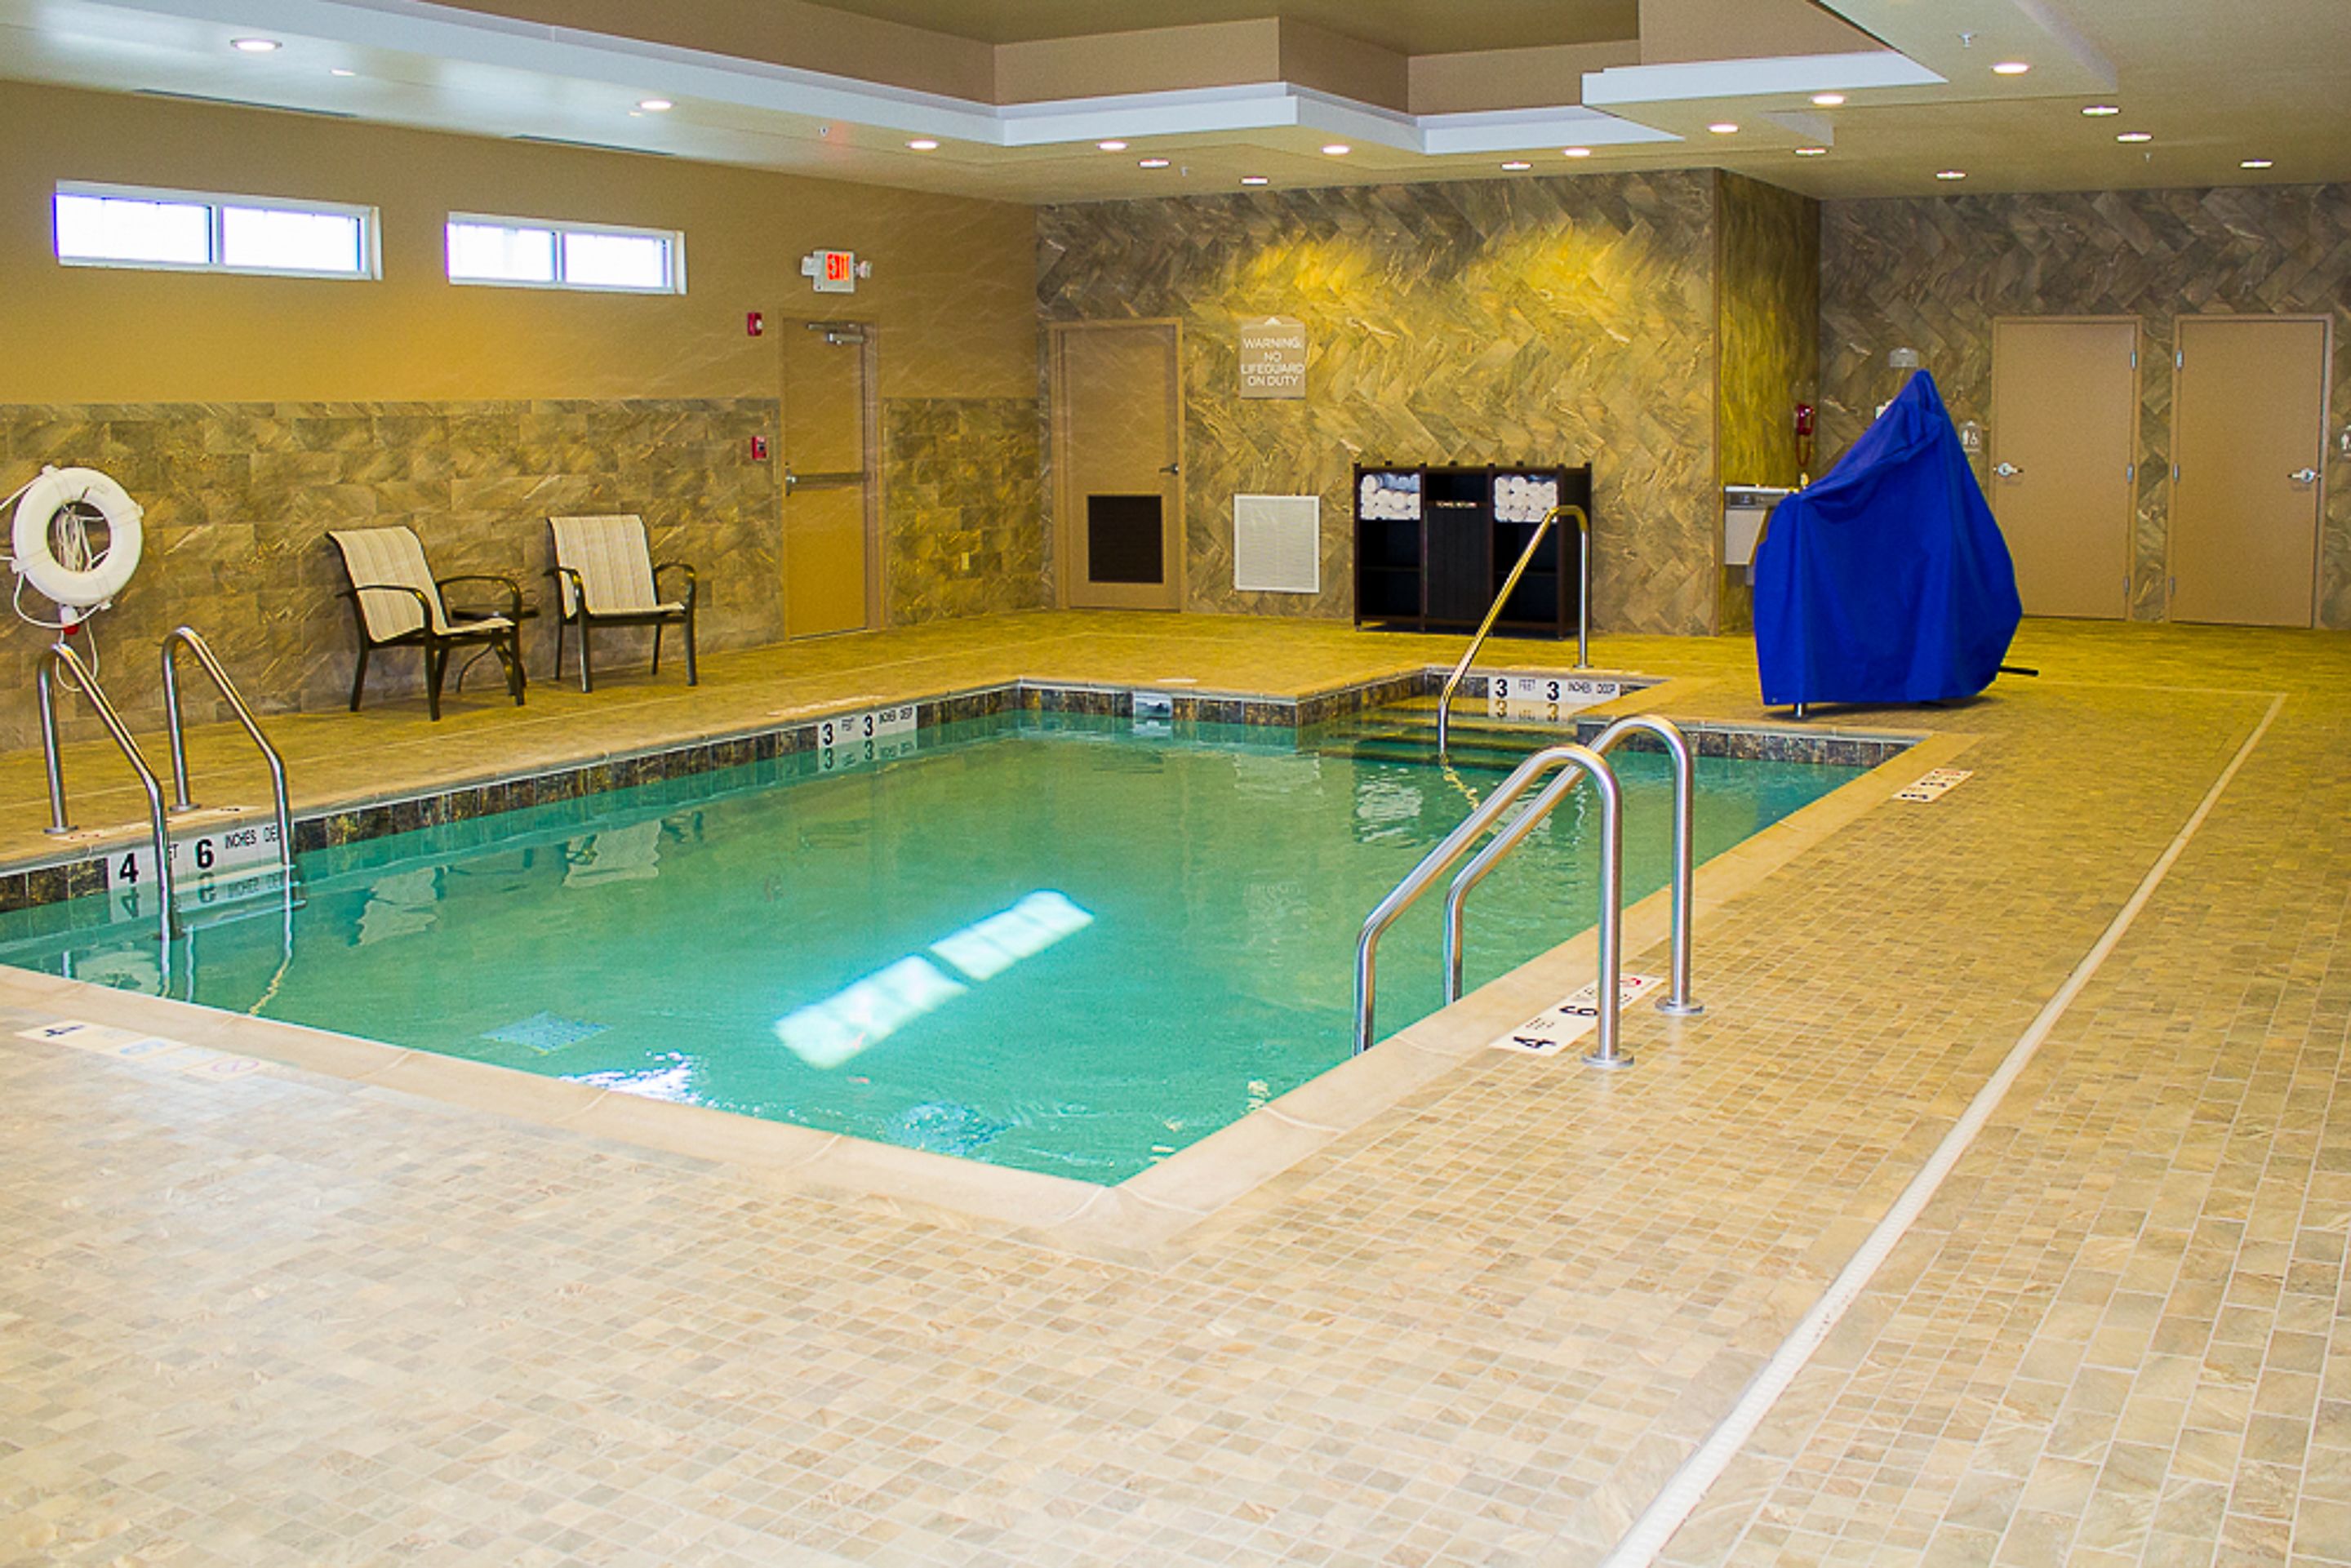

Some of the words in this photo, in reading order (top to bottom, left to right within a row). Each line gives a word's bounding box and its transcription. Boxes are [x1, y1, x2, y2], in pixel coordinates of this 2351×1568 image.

[827, 253, 850, 281] EXIT
[1241, 363, 1305, 375] LIFEGUARD
[1264, 351, 1282, 363] NO
[1247, 375, 1265, 386] ON
[1267, 375, 1299, 386] DUTY
[1495, 679, 1508, 698] 3
[1547, 681, 1559, 701] 3
[823, 722, 833, 746] 3
[863, 715, 873, 737] 3
[119, 852, 139, 883] 4
[196, 839, 215, 868] 6
[225, 828, 257, 850] INCHES
[264, 824, 280, 842] DE
[1513, 1036, 1557, 1049] 4
[1559, 1005, 1598, 1016] 6
